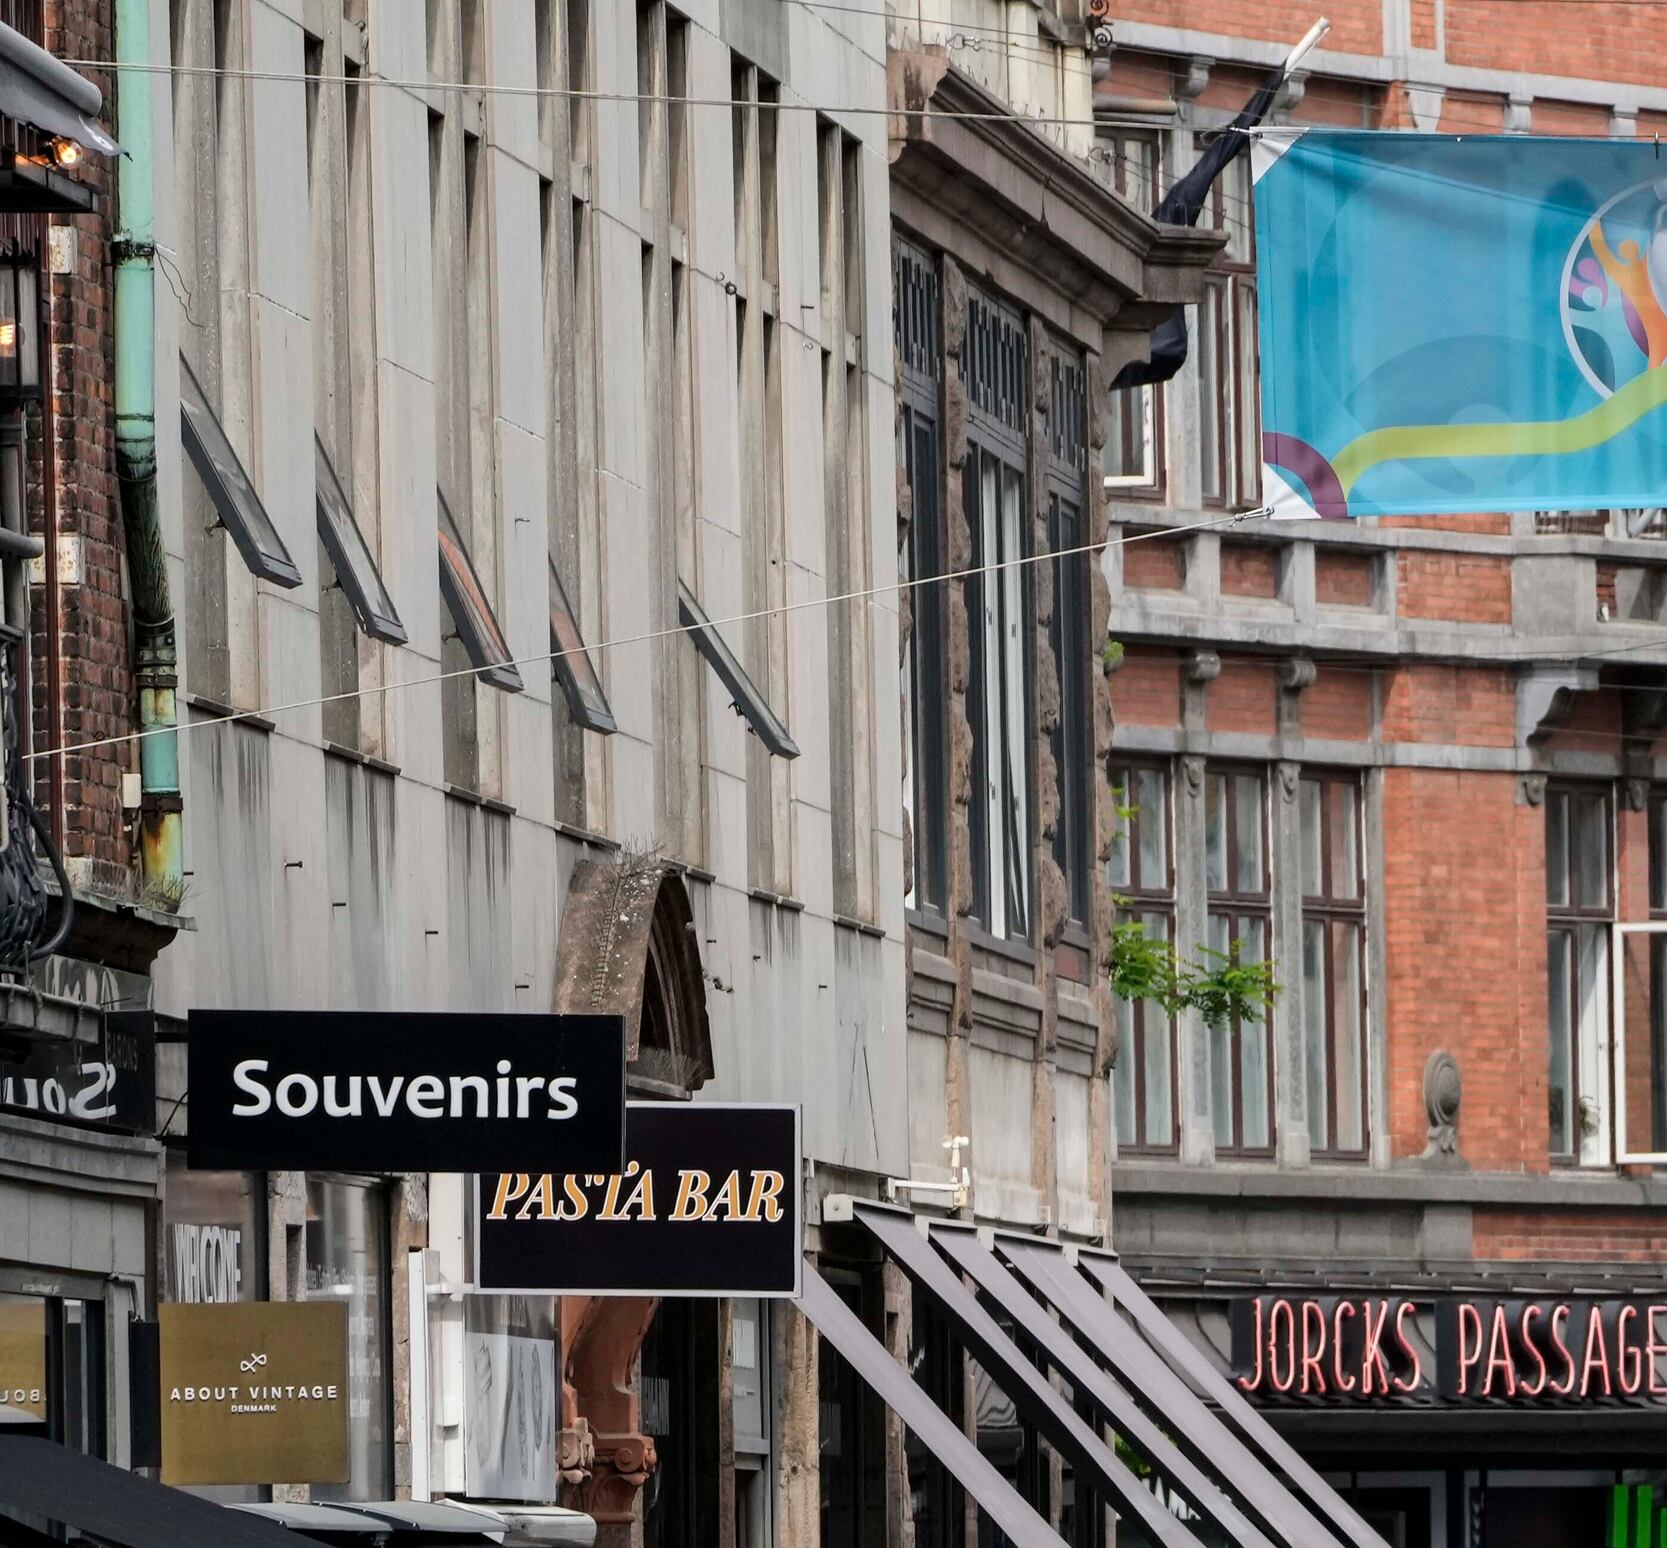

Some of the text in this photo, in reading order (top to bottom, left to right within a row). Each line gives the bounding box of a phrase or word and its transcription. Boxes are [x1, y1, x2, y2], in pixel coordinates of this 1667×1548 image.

[231, 1059, 579, 1121] Souvenirs
[486, 1160, 785, 1223] PASTA BAR
[1237, 1297, 1422, 1395] JORCKS
[170, 1385, 339, 1401] ABOUT VINTAGE
[230, 1404, 278, 1414] DENMARK
